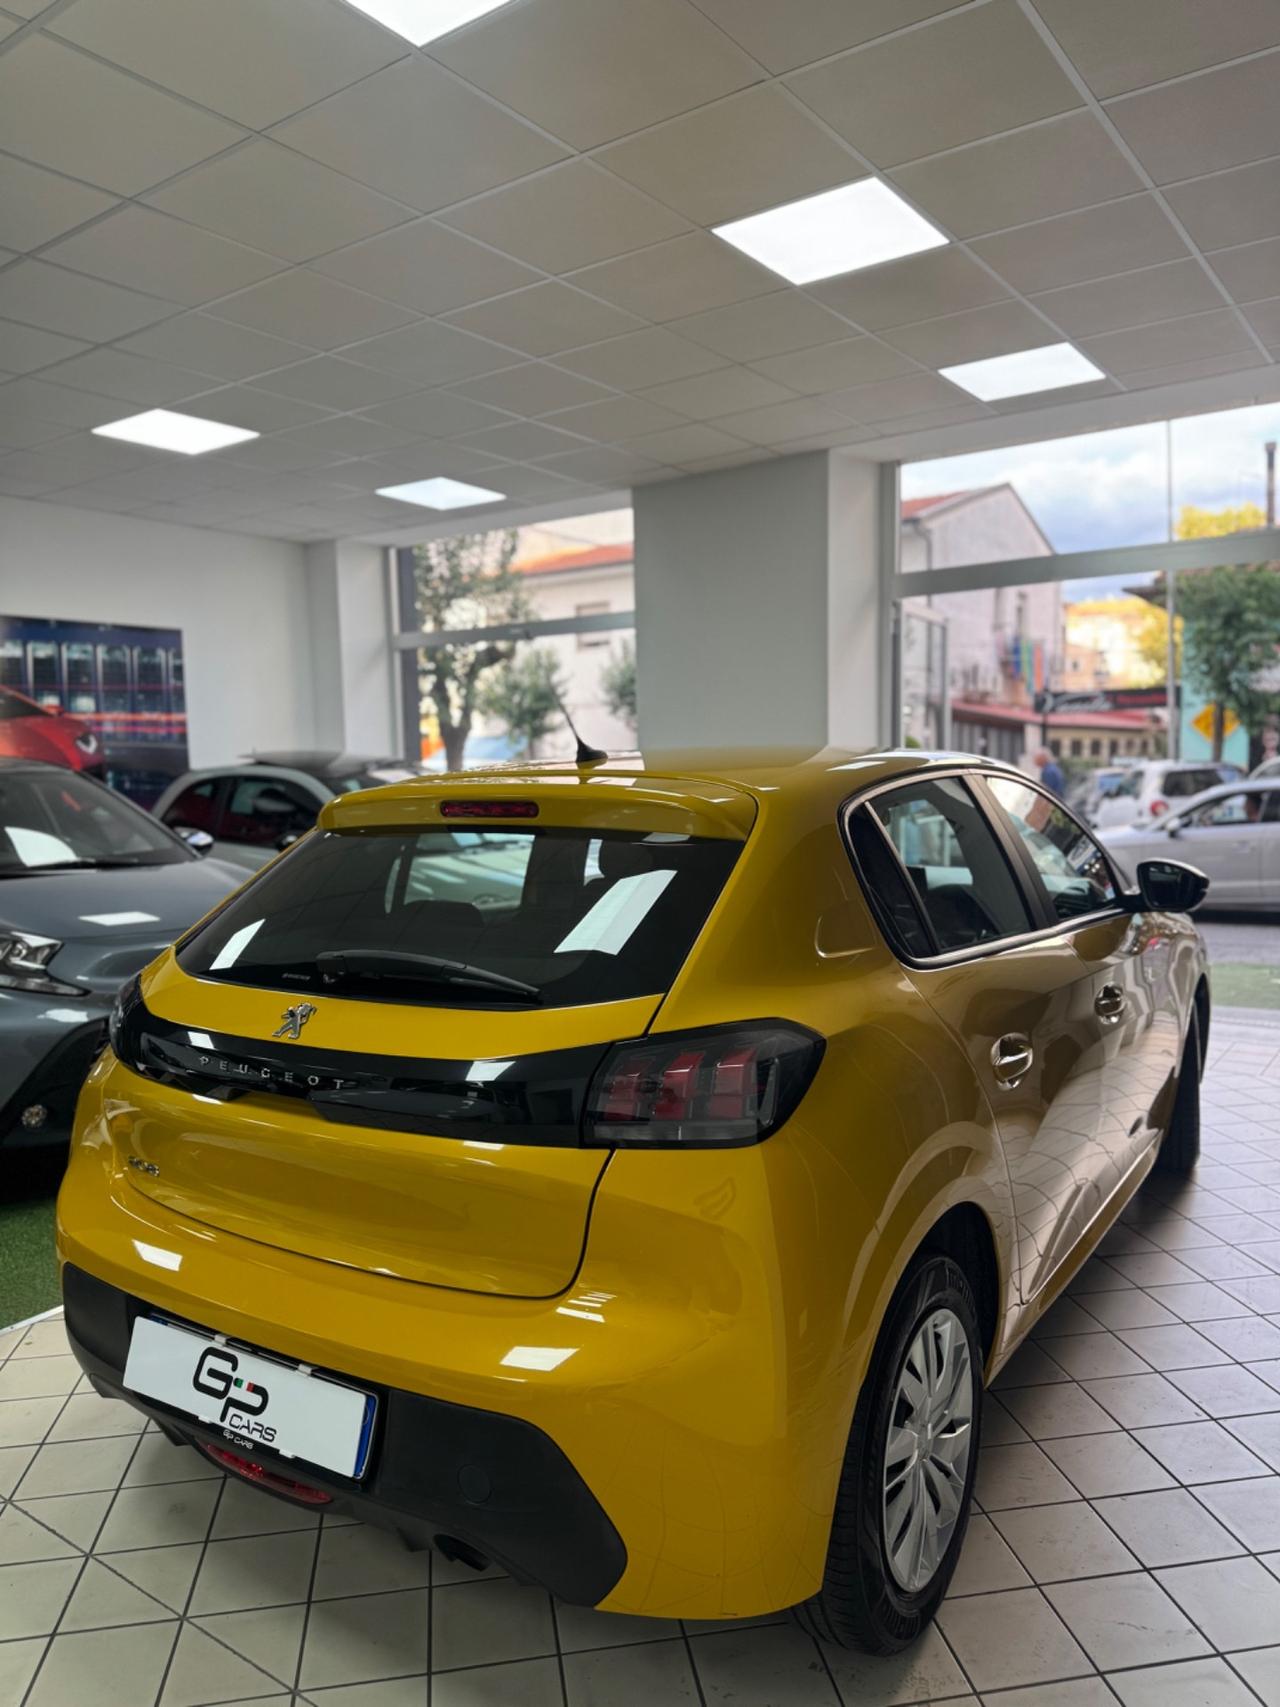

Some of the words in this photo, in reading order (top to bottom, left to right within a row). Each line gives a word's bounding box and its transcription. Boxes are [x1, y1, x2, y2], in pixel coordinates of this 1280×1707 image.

[199, 1055, 345, 1090] PEUGEOT
[192, 1346, 269, 1423] GP
[229, 1413, 277, 1443] CARS
